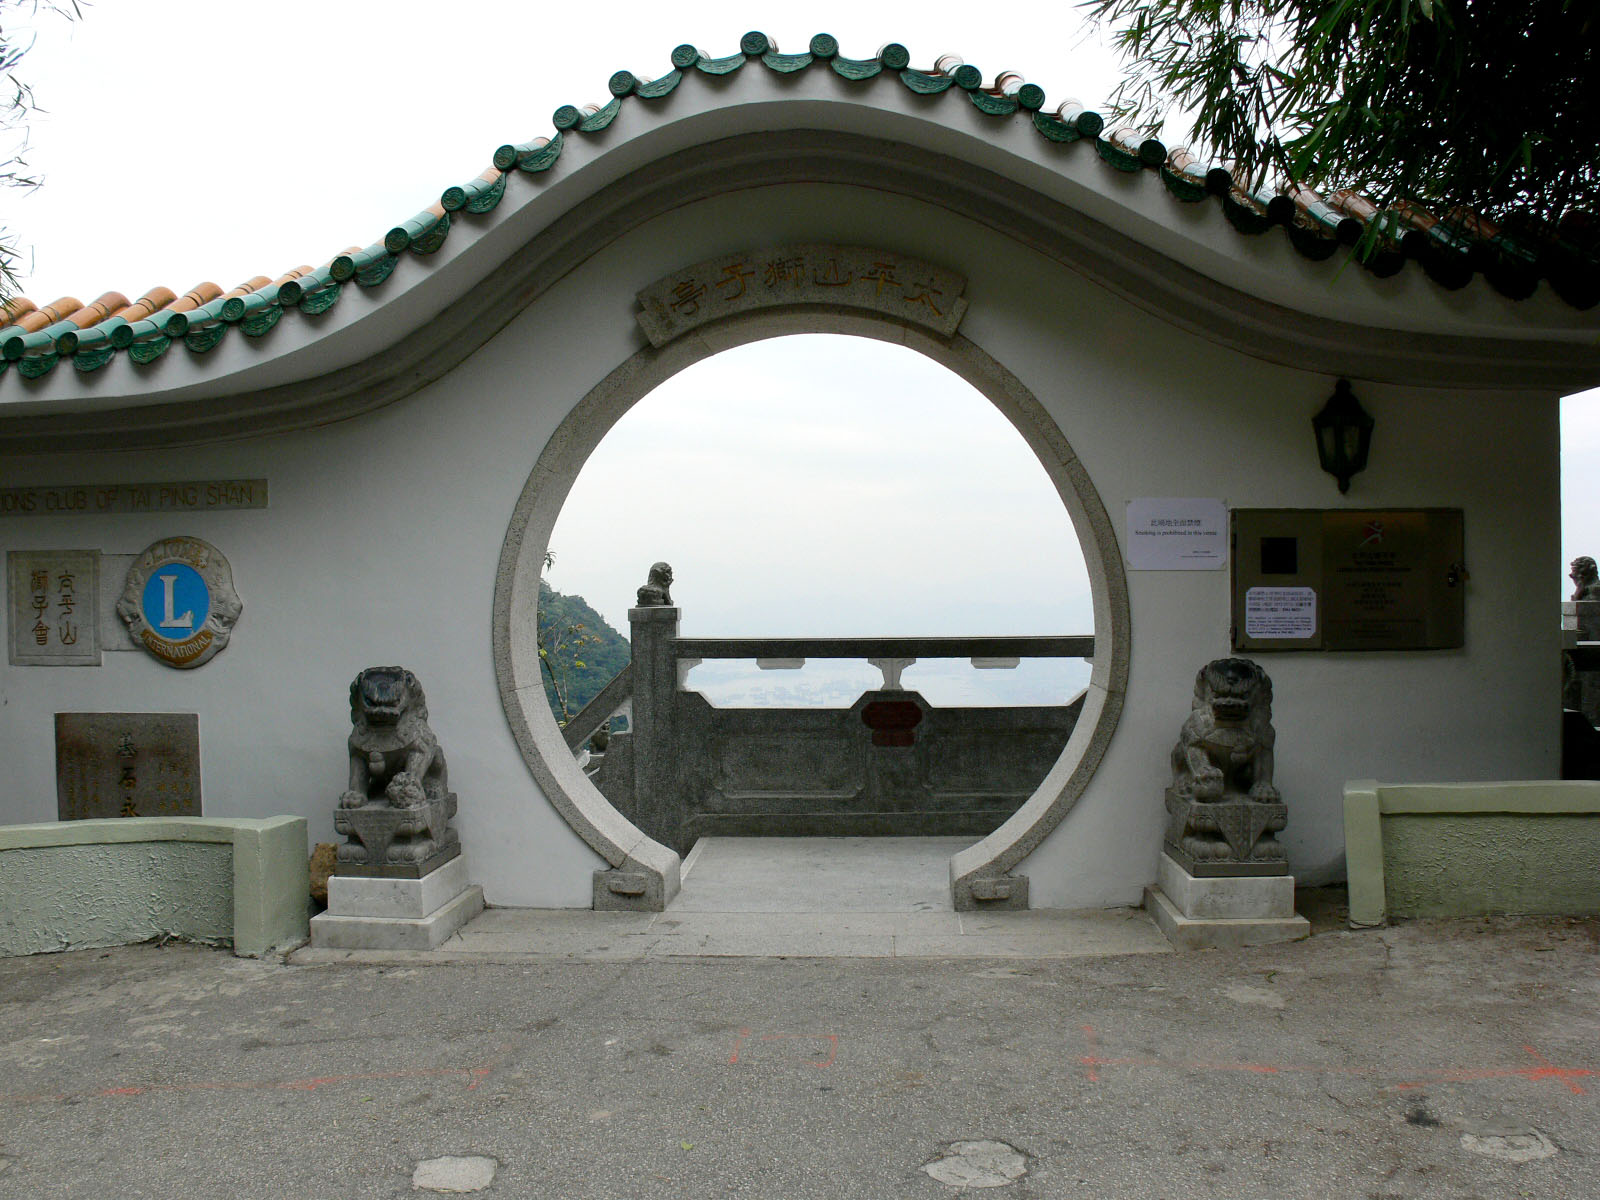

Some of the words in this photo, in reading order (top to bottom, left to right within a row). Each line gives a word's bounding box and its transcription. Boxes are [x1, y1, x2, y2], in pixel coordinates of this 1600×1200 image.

[46, 490, 88, 510] CLUB
[96, 490, 120, 508] OF
[128, 488, 151, 508] TAI
[160, 487, 197, 506] PING
[206, 485, 254, 505] SHAN
[159, 575, 194, 628] L
[145, 634, 210, 658] INTERNATIONAL
